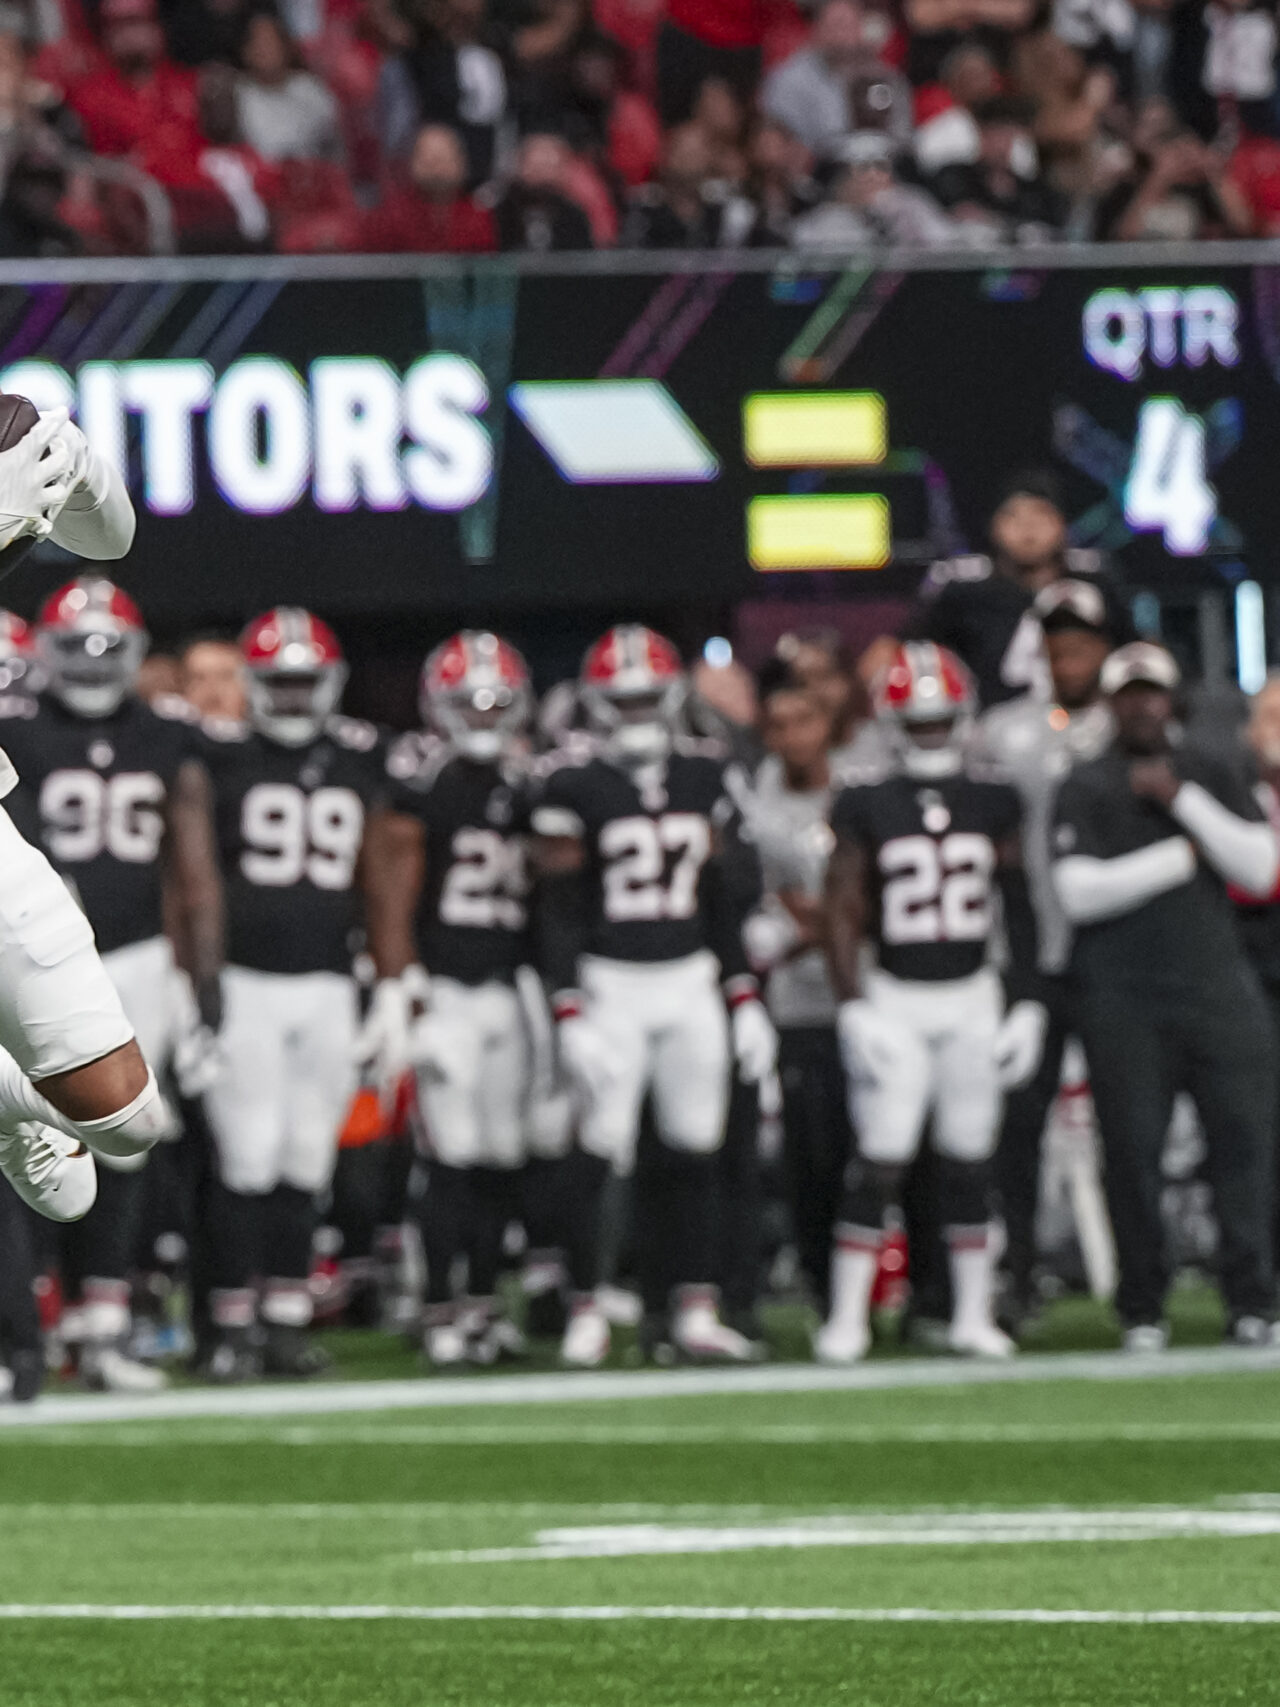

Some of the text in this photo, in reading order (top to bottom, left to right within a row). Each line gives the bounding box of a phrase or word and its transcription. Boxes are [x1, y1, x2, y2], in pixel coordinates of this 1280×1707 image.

[1082, 285, 1239, 381] QTR
[1124, 394, 1217, 556] 4
[39, 768, 167, 864] 96
[240, 783, 365, 891] 99
[598, 811, 712, 922] 27
[878, 832, 997, 946] 22
